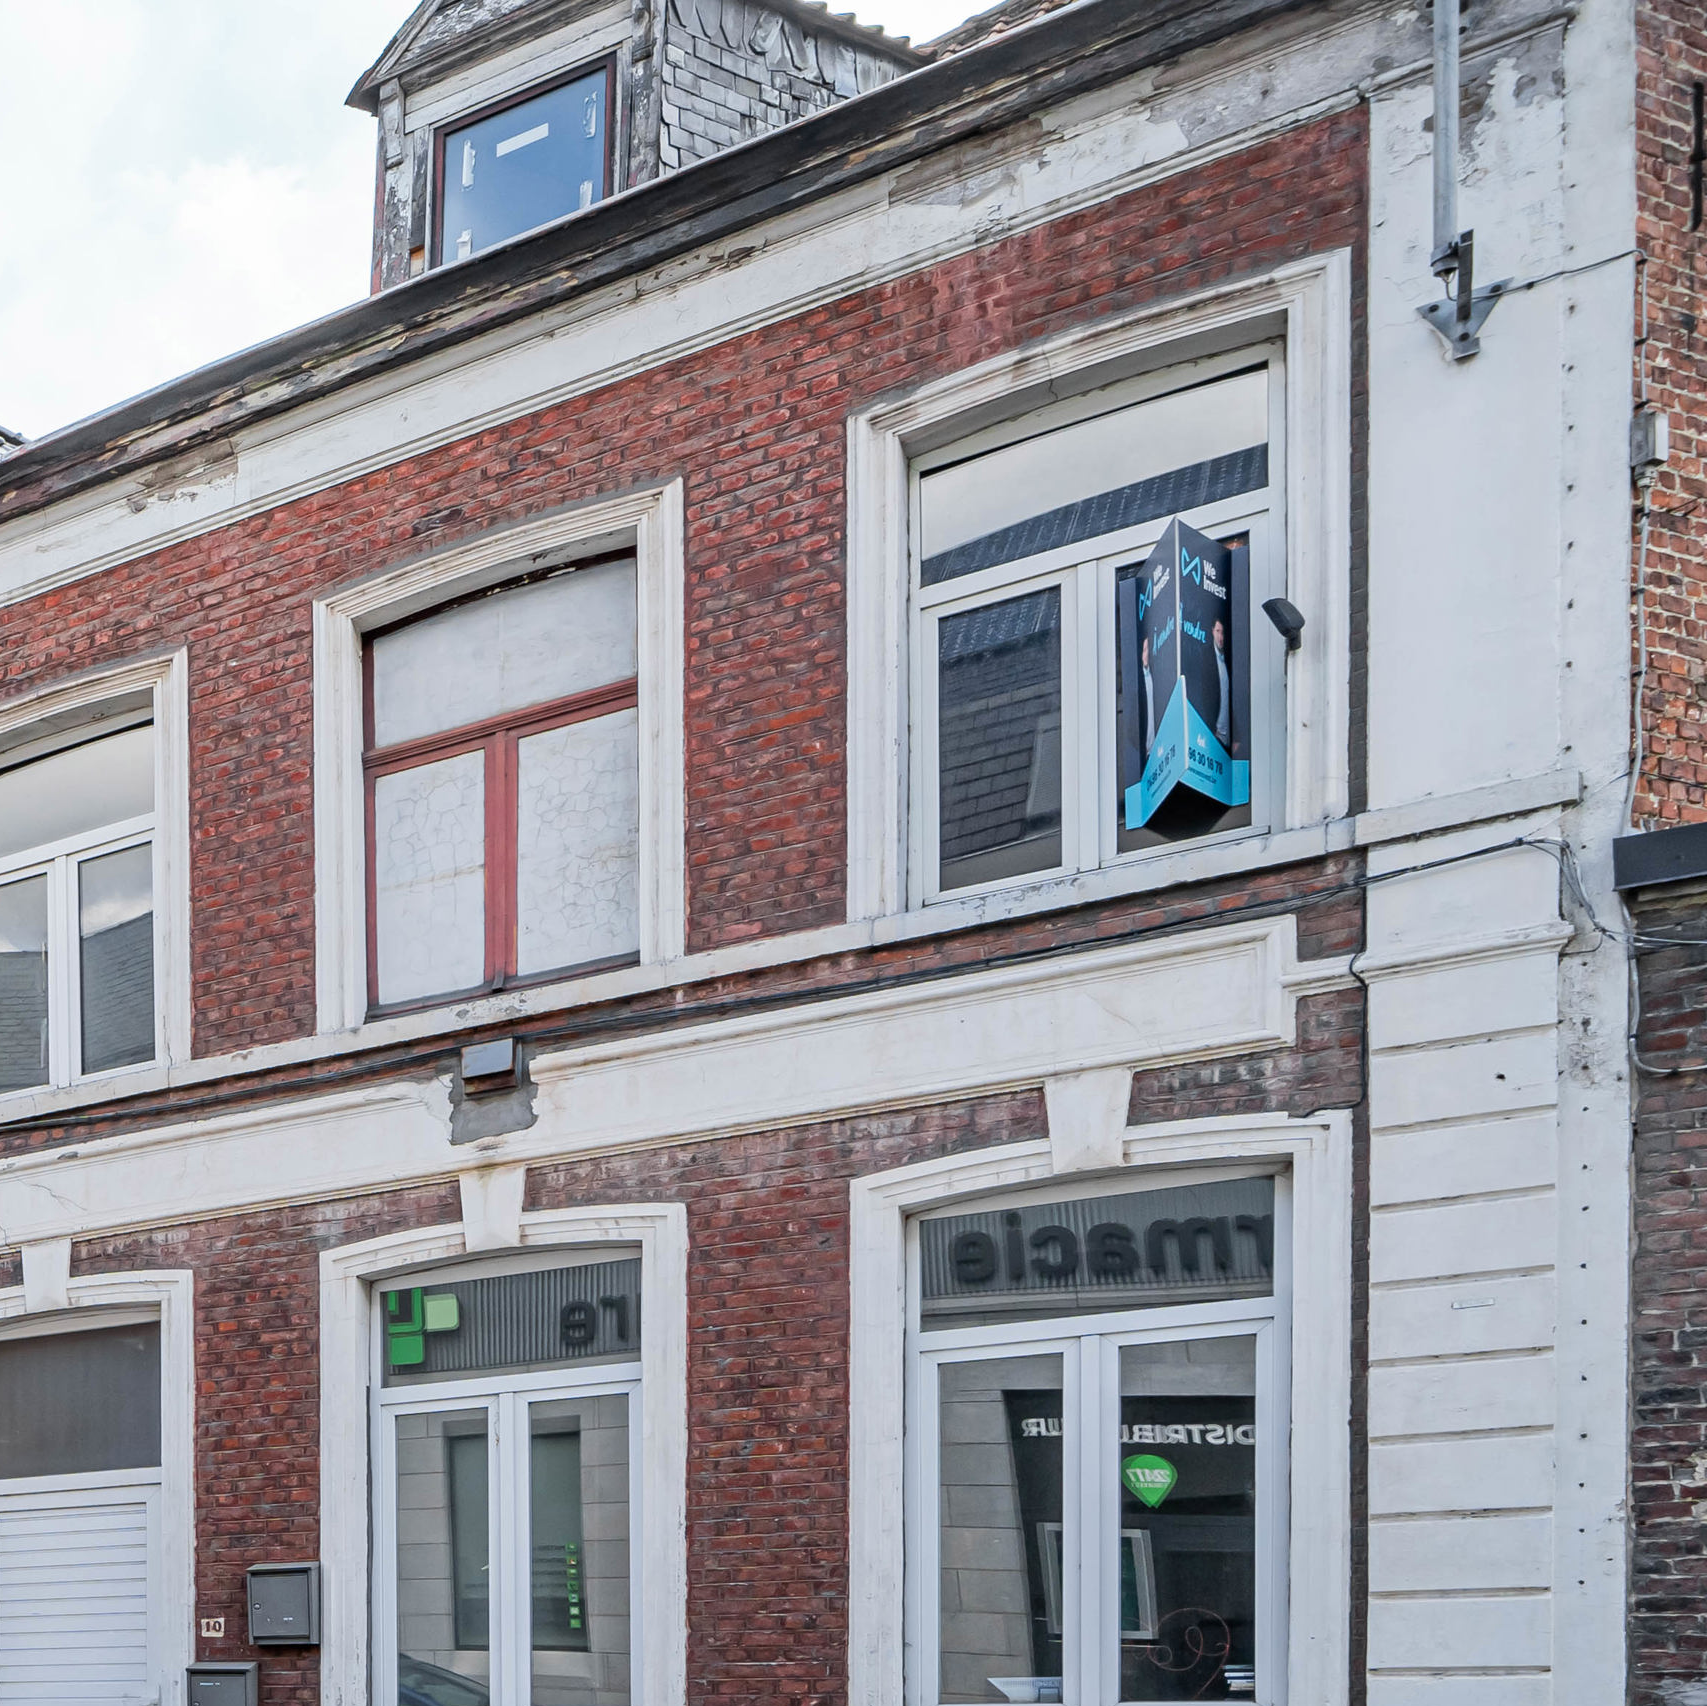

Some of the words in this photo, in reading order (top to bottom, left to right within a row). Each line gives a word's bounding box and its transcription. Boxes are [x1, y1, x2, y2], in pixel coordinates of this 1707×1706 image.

[1203, 559, 1217, 579] We
[1203, 576, 1227, 600] Invest
[205, 1620, 222, 1632] 10
